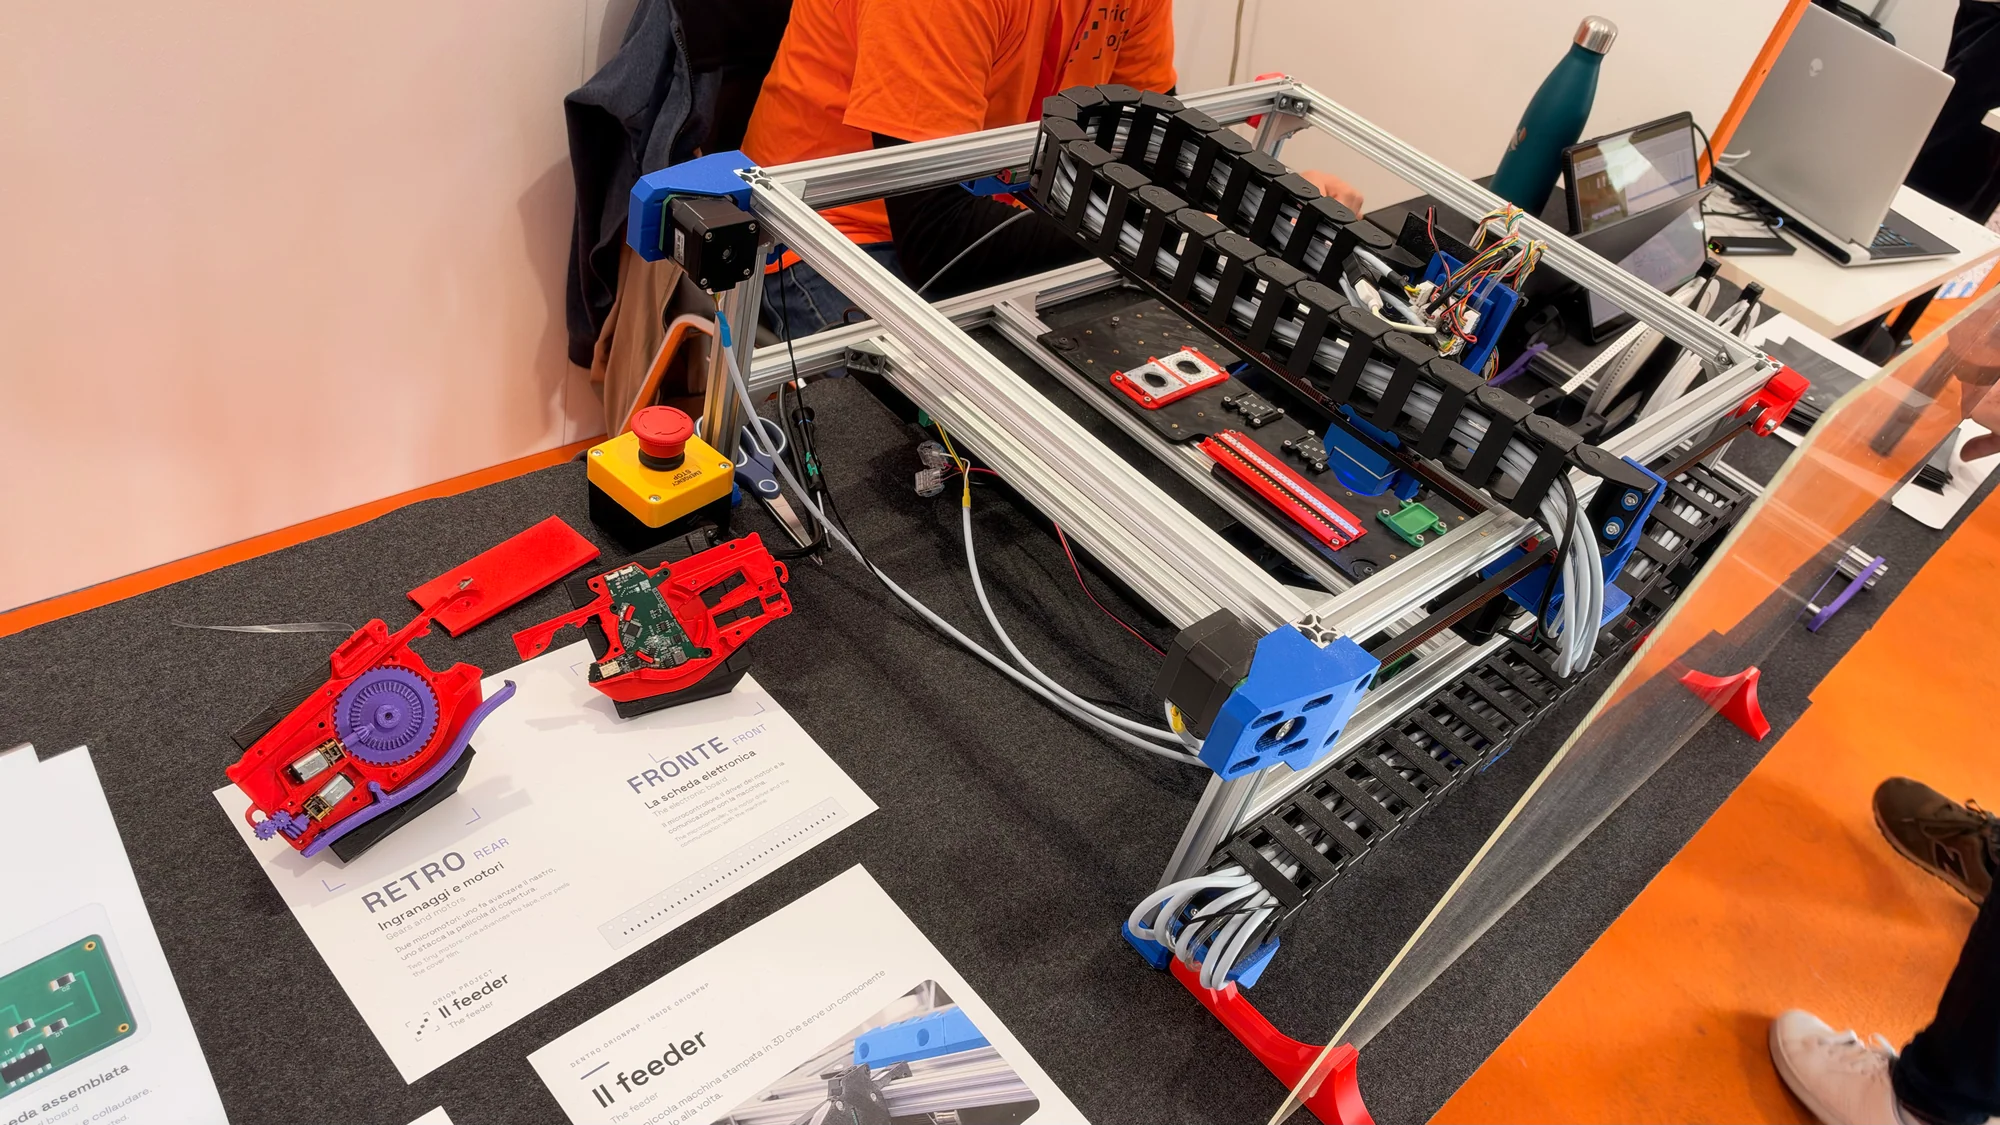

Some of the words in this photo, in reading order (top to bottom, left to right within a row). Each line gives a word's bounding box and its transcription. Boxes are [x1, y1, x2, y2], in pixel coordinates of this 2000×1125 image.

[627, 736, 729, 794] FRONTE
[732, 723, 766, 745] FRONT
[644, 800, 661, 809] La
[661, 779, 701, 801] scheda
[702, 751, 756, 781] elettronica
[652, 808, 669, 817] The
[669, 789, 706, 810] electronic
[705, 776, 728, 791] board
[361, 852, 465, 913] RETRO
[473, 838, 509, 860] REAR
[378, 889, 450, 931] Ingranaggi
[463, 861, 504, 887] motori
[385, 924, 413, 940] Gears
[414, 913, 432, 927] and
[433, 897, 466, 916] motors
[394, 942, 412, 953] Due
[412, 916, 460, 944] micromotori:
[462, 907, 478, 917] uno
[488, 884, 523, 904] avanzare
[529, 868, 556, 883] nastro,
[400, 950, 417, 961] uno
[418, 935, 447, 952] stacca
[455, 912, 489, 933] pellicola
[489, 906, 498, 914] di
[498, 888, 537, 909] copertura.
[432, 990, 457, 1006] ORION
[458, 969, 493, 991] PROJECT
[438, 1005, 451, 1018] Il
[452, 974, 508, 1010] feeder
[448, 1018, 465, 1028] The
[465, 1001, 493, 1019] feeder
[570, 1047, 601, 1068] DENTRO
[647, 1005, 672, 1022] INSIDE
[678, 1077, 722, 1107] macchina
[722, 1050, 764, 1079] stampata
[762, 1044, 773, 1053] in
[771, 1035, 785, 1046] 3D
[785, 1025, 802, 1038] che
[802, 1010, 825, 1027] serve
[825, 1003, 837, 1012] un
[837, 970, 886, 1004] componente
[41, 1064, 130, 1112] assemblata
[592, 1084, 615, 1108] Il
[616, 1031, 706, 1093] feeder
[46, 1103, 80, 1125] board
[92, 1088, 153, 1121] collaudare.
[609, 1112, 629, 1124] The
[629, 1092, 658, 1113] feeder
[680, 1109, 698, 1121] alla
[696, 1093, 723, 1110] volta.
